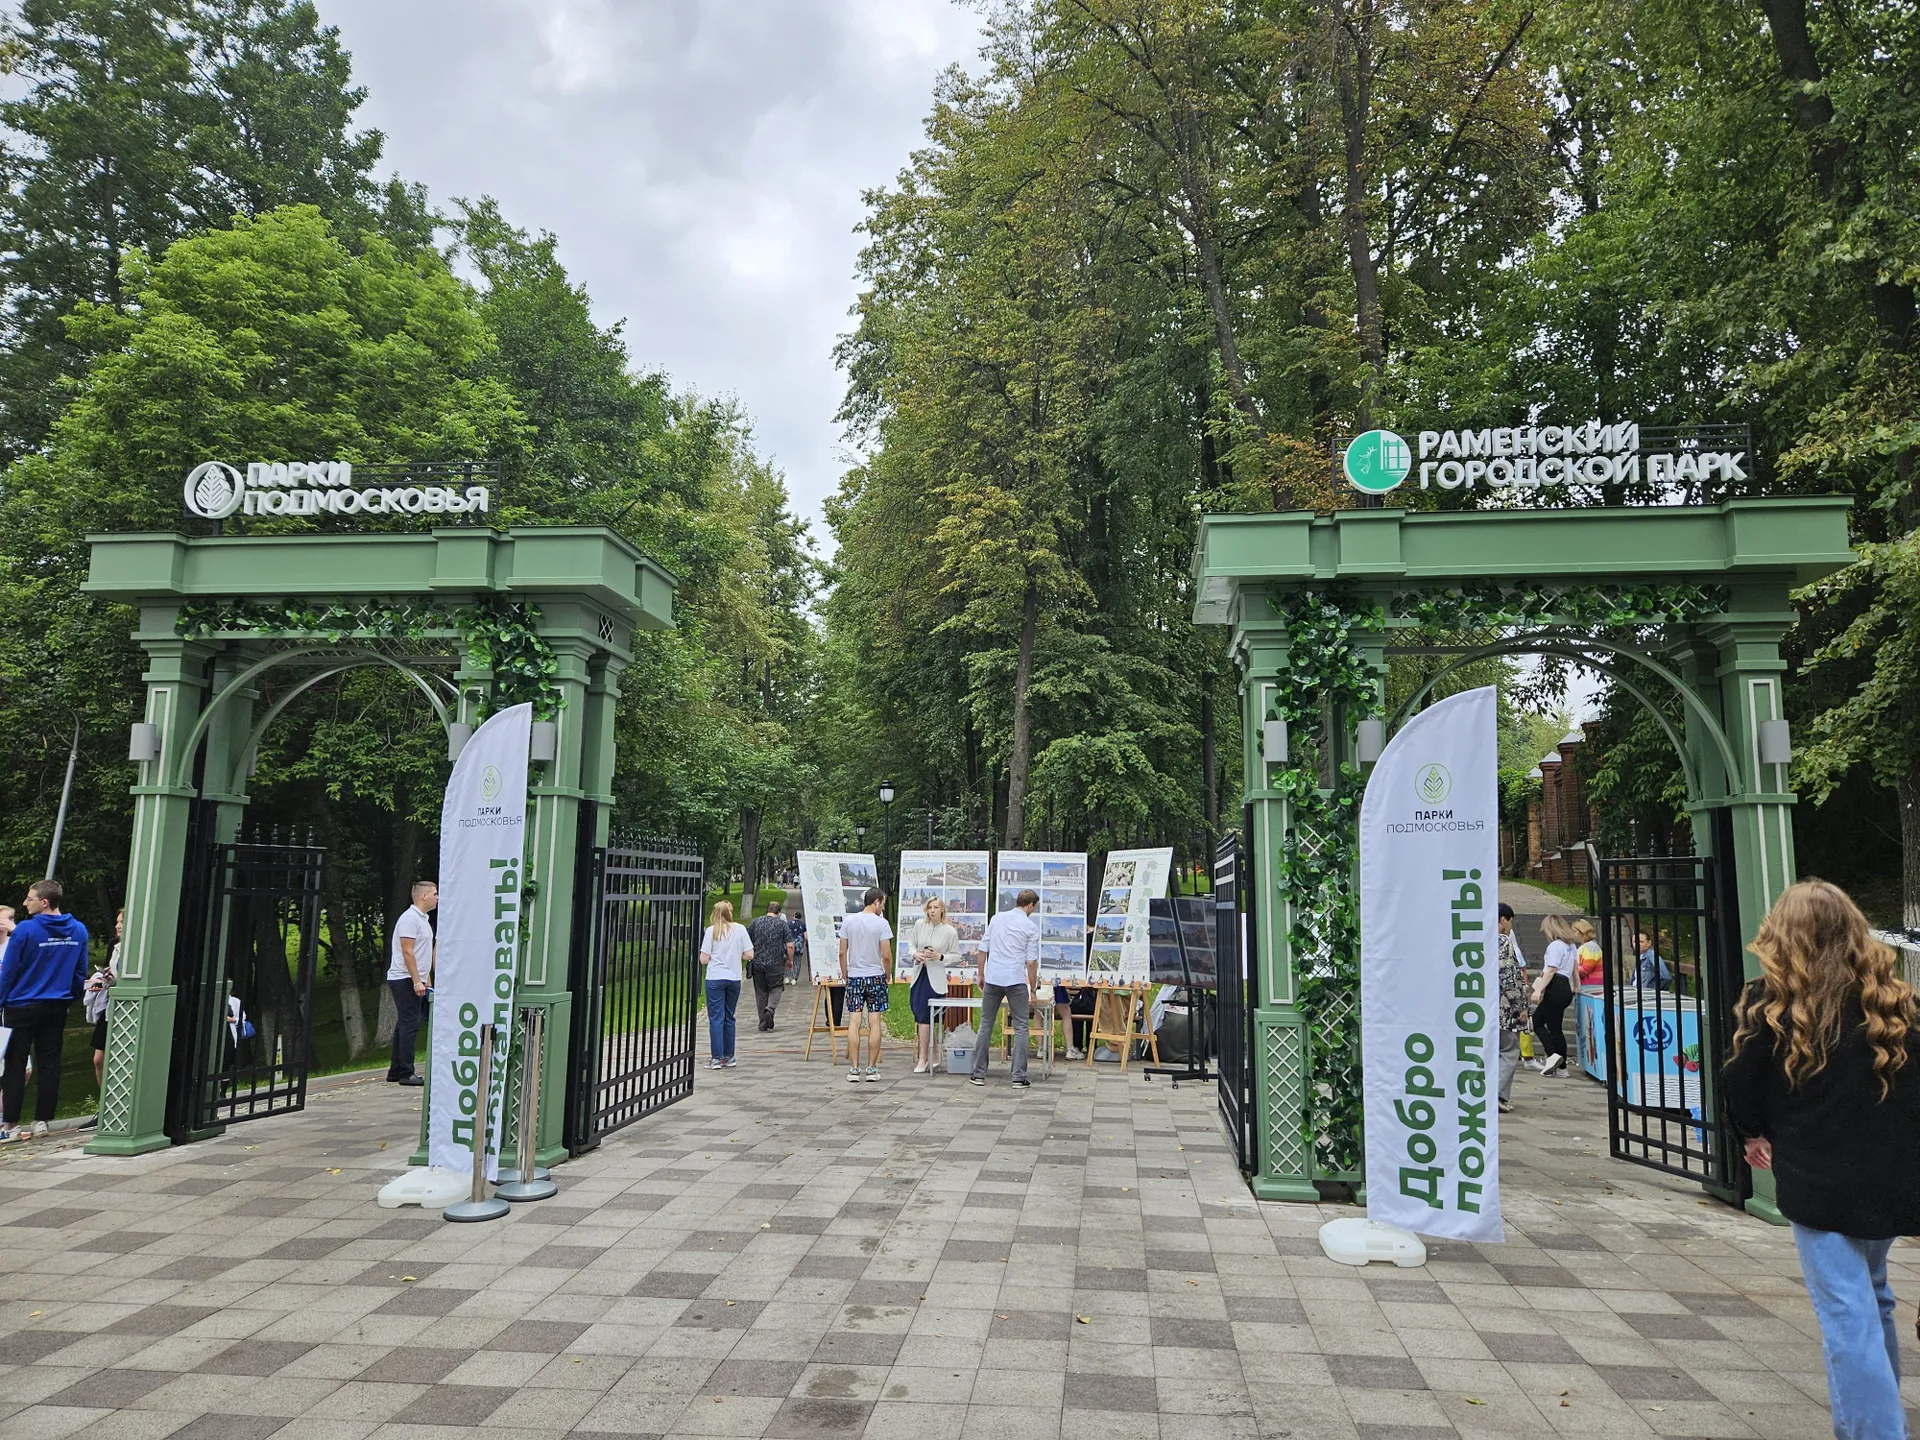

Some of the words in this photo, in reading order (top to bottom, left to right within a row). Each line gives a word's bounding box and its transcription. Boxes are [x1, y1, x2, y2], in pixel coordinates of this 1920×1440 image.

[1418, 420, 1640, 459] РАМЕНСКИЙ
[246, 461, 352, 487] ПАРКИ
[1419, 453, 1640, 490] ГОРОДСКОЙ
[1646, 451, 1749, 483] ПАРК
[243, 486, 490, 516] ПОДМОСКОВЬЯ
[458, 815, 522, 828] ПОДМОСКОВЬЯ
[477, 806, 502, 816] ПАРКИ
[1415, 809, 1453, 821] ПАРКИ
[1386, 820, 1484, 834] ПОДМОСКОВЬЯ
[1442, 868, 1486, 1214] пожаловать!
[451, 1002, 480, 1153] Добро
[1393, 1032, 1445, 1209] Добро
